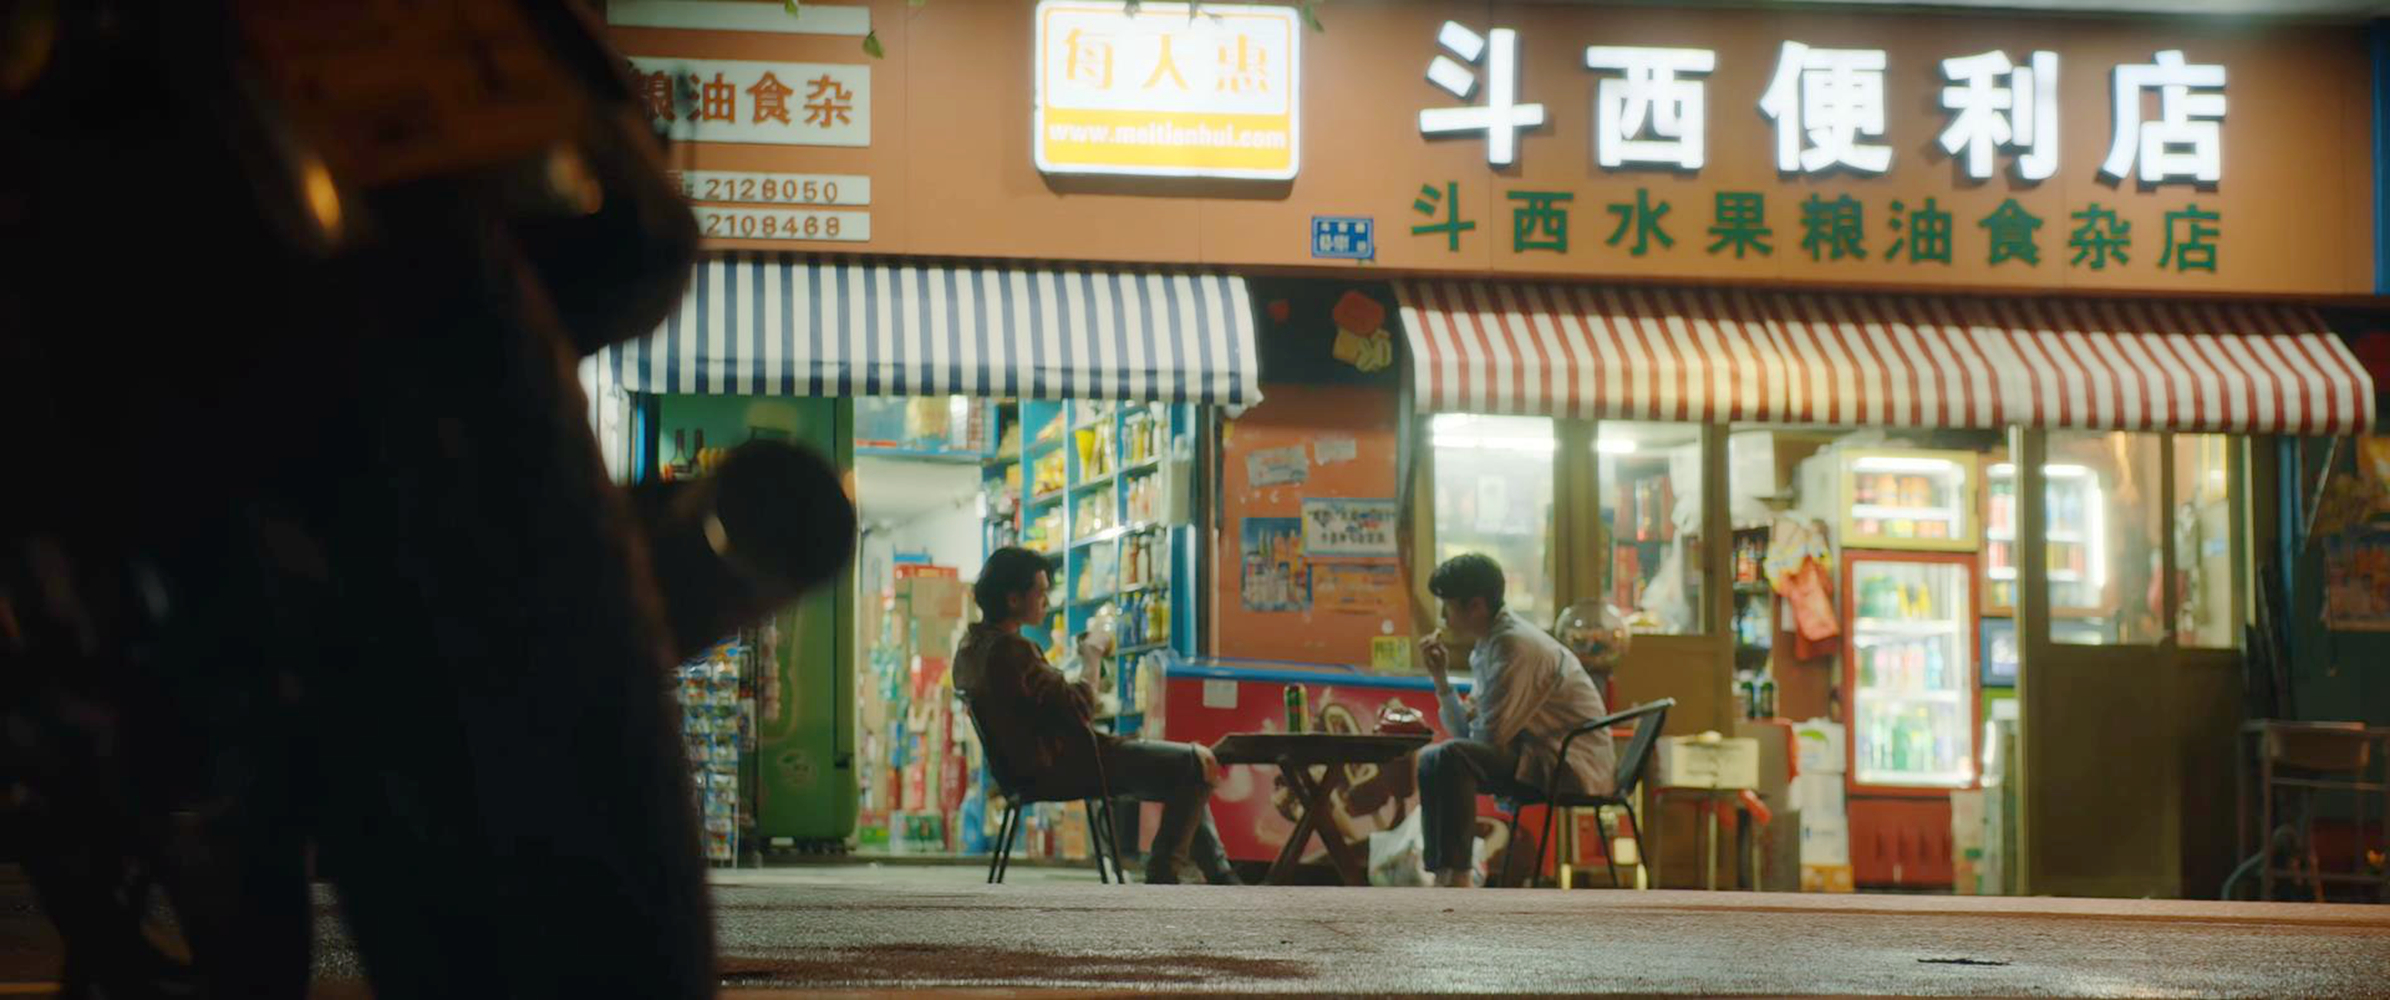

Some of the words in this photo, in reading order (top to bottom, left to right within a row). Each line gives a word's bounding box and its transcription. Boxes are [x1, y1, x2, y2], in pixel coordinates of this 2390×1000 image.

[1419, 20, 2227, 181] 斗西便利店
[705, 178, 838, 203] 2128050
[1411, 181, 2222, 272] 斗西水果粮油食杂店
